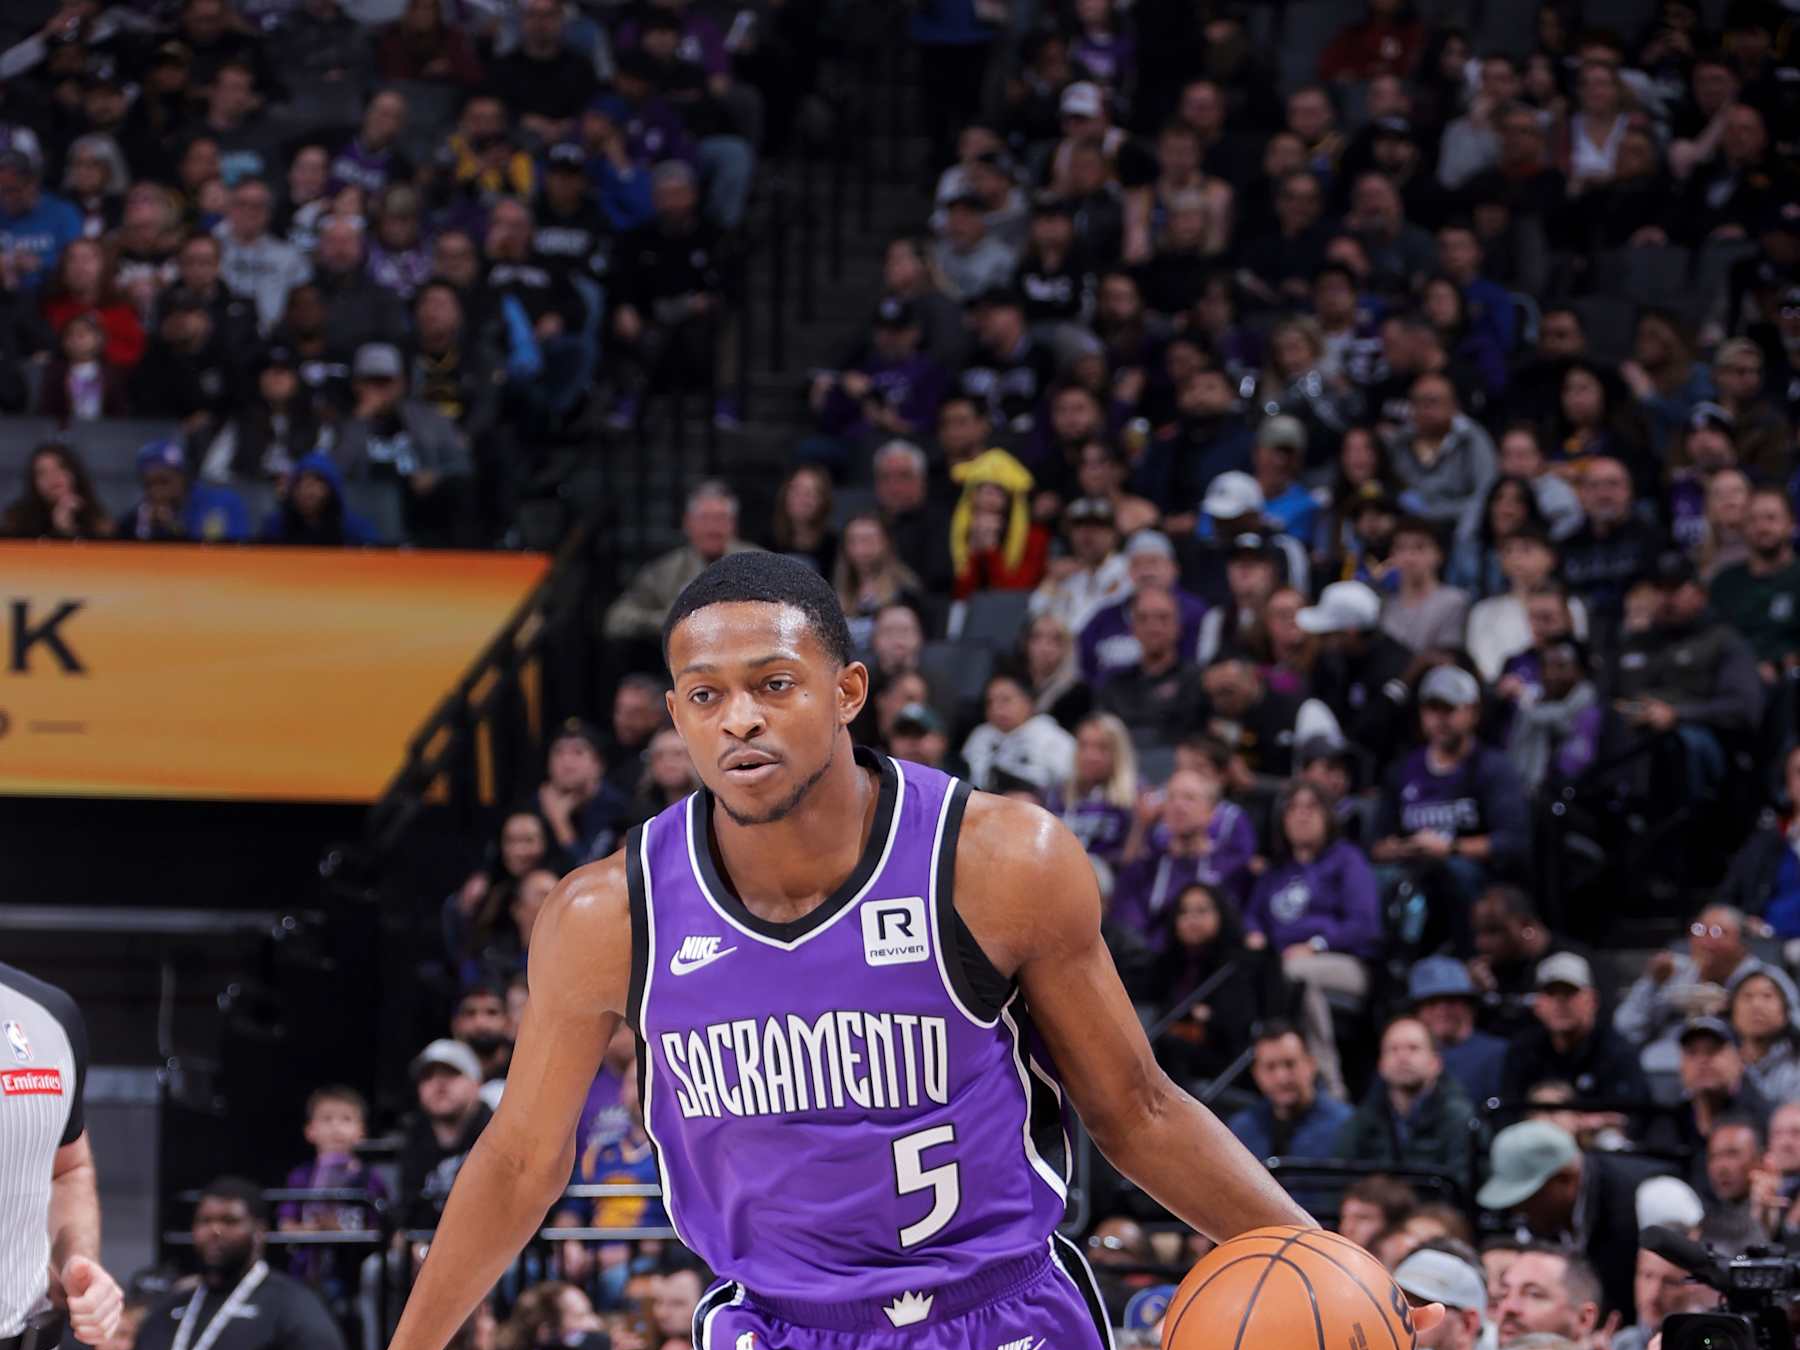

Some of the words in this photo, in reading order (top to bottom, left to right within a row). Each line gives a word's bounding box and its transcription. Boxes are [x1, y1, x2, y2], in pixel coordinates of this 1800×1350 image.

[877, 908, 914, 940] R
[679, 935, 721, 960] NIKE
[870, 945, 924, 957] REVIVER
[661, 1010, 949, 1119] SACRAMENTO
[1, 1072, 62, 1092] Emirates
[892, 1123, 960, 1248] 5
